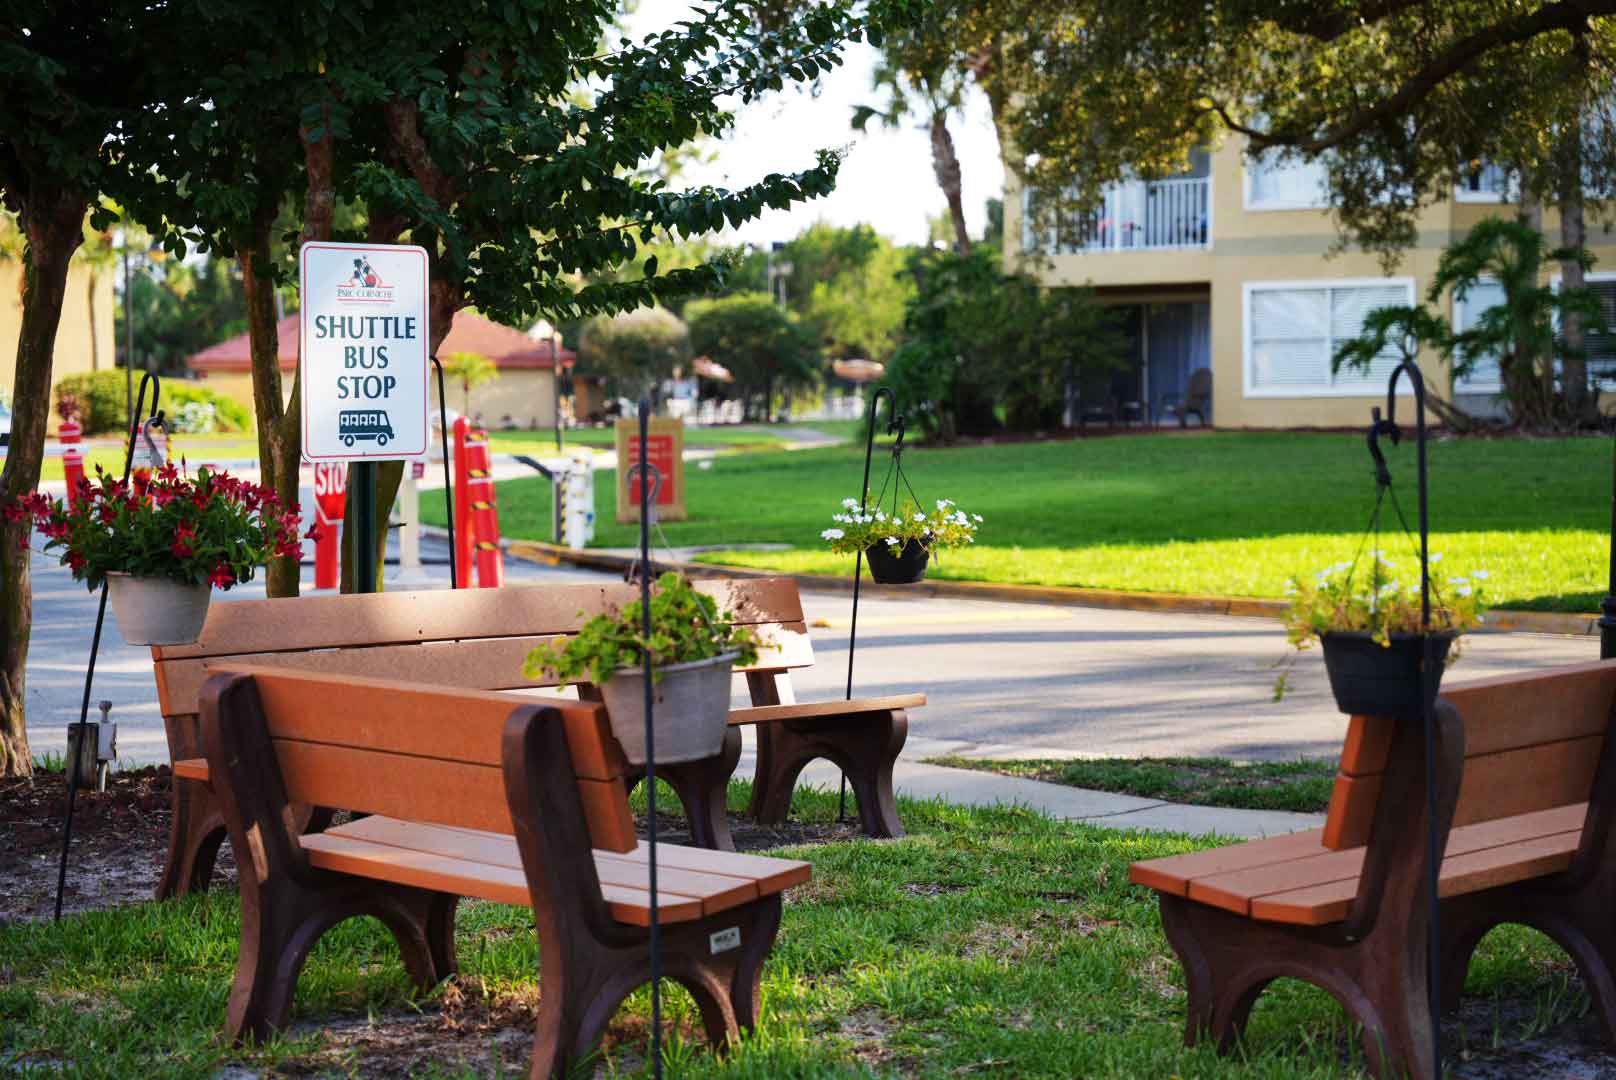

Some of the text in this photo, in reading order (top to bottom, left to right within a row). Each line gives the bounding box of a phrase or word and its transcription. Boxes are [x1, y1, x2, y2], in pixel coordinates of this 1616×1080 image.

[315, 315, 416, 339] SHUTTLE
[344, 346, 388, 369] BUS
[337, 375, 396, 399] STOP
[316, 462, 346, 495] STO
